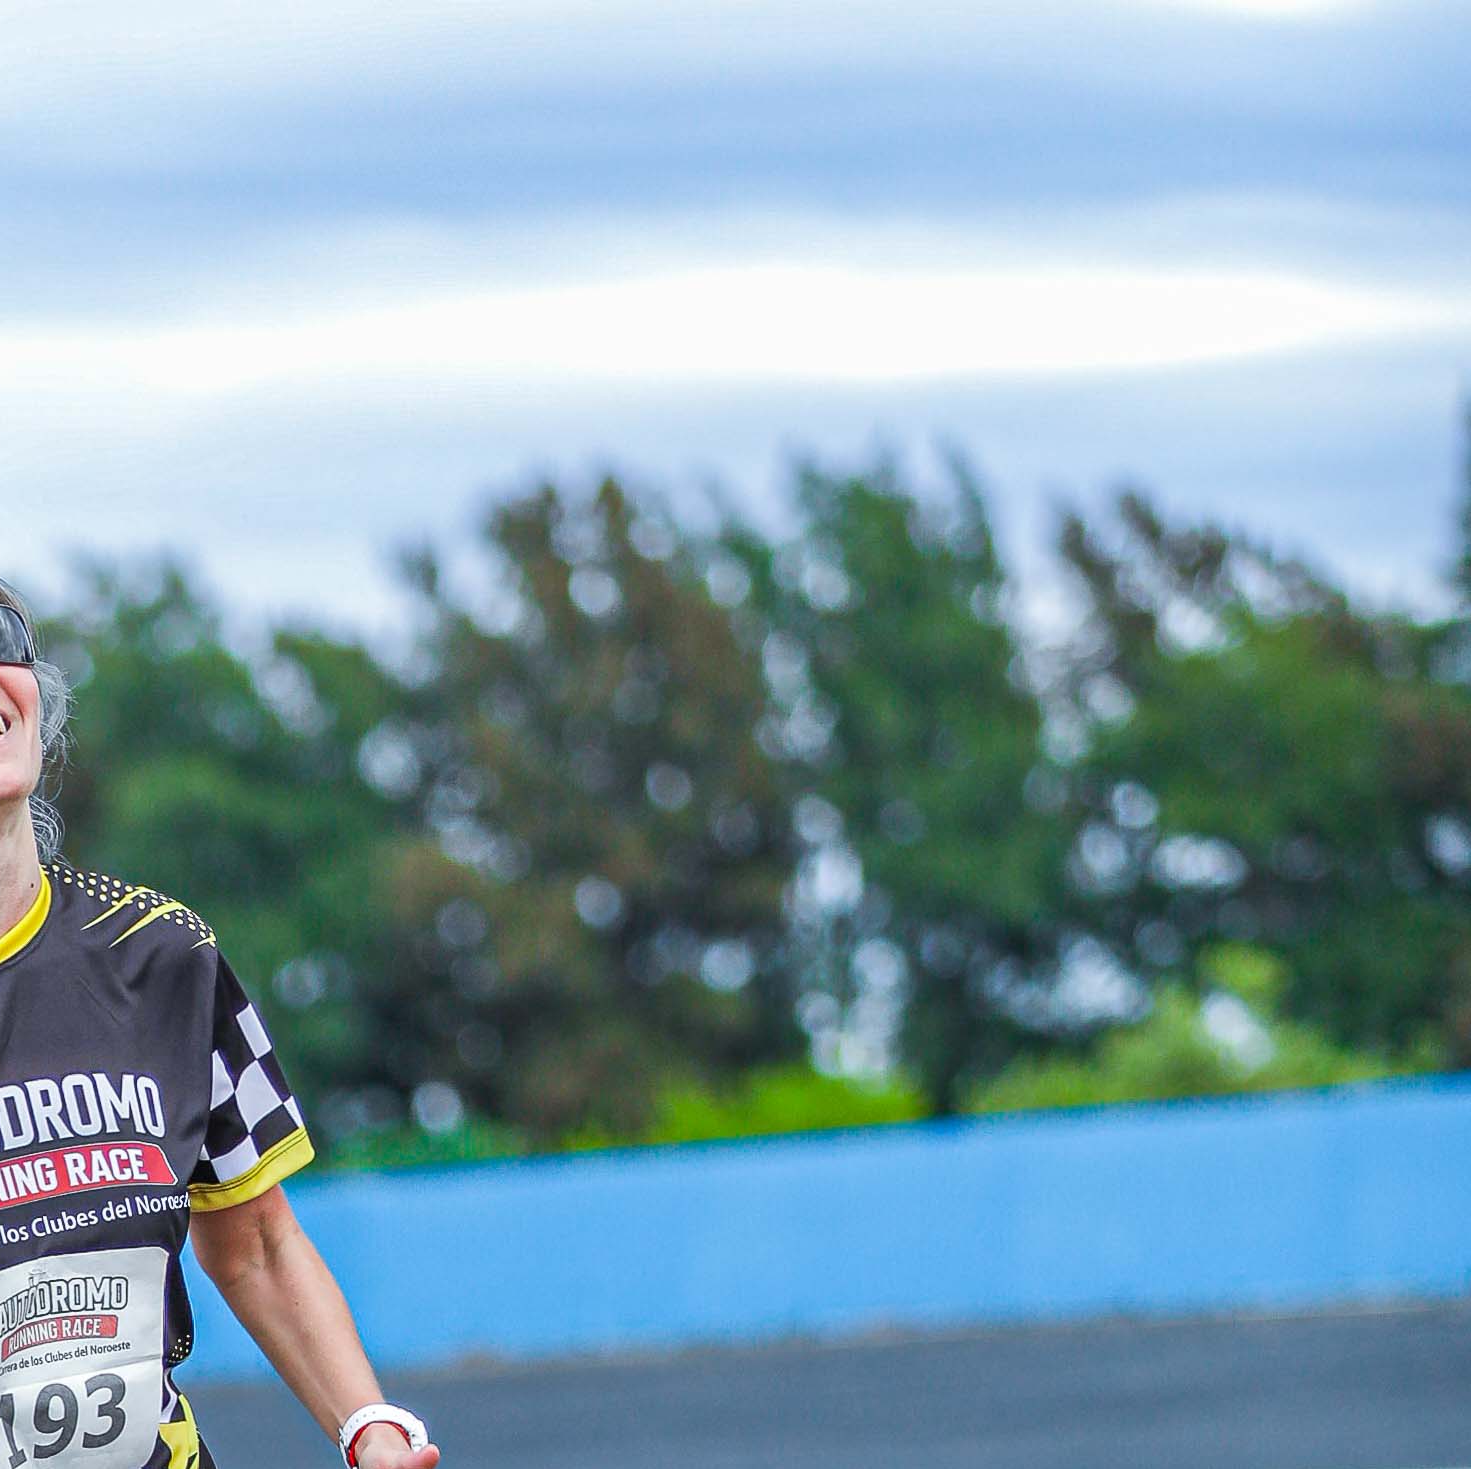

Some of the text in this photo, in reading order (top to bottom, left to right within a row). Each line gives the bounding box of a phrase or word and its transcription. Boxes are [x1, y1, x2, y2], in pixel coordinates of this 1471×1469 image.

[64, 1148, 149, 1187] RACE
[0, 1222, 29, 1244] los
[31, 1210, 98, 1237] Clubes
[101, 1198, 133, 1222] del
[8, 1318, 102, 1355] RUNNING RACE
[18, 1358, 30, 1369] de
[30, 1355, 44, 1367] los
[44, 1349, 74, 1364] Clubes
[74, 1345, 89, 1358] del
[89, 1340, 131, 1356] Noroeste
